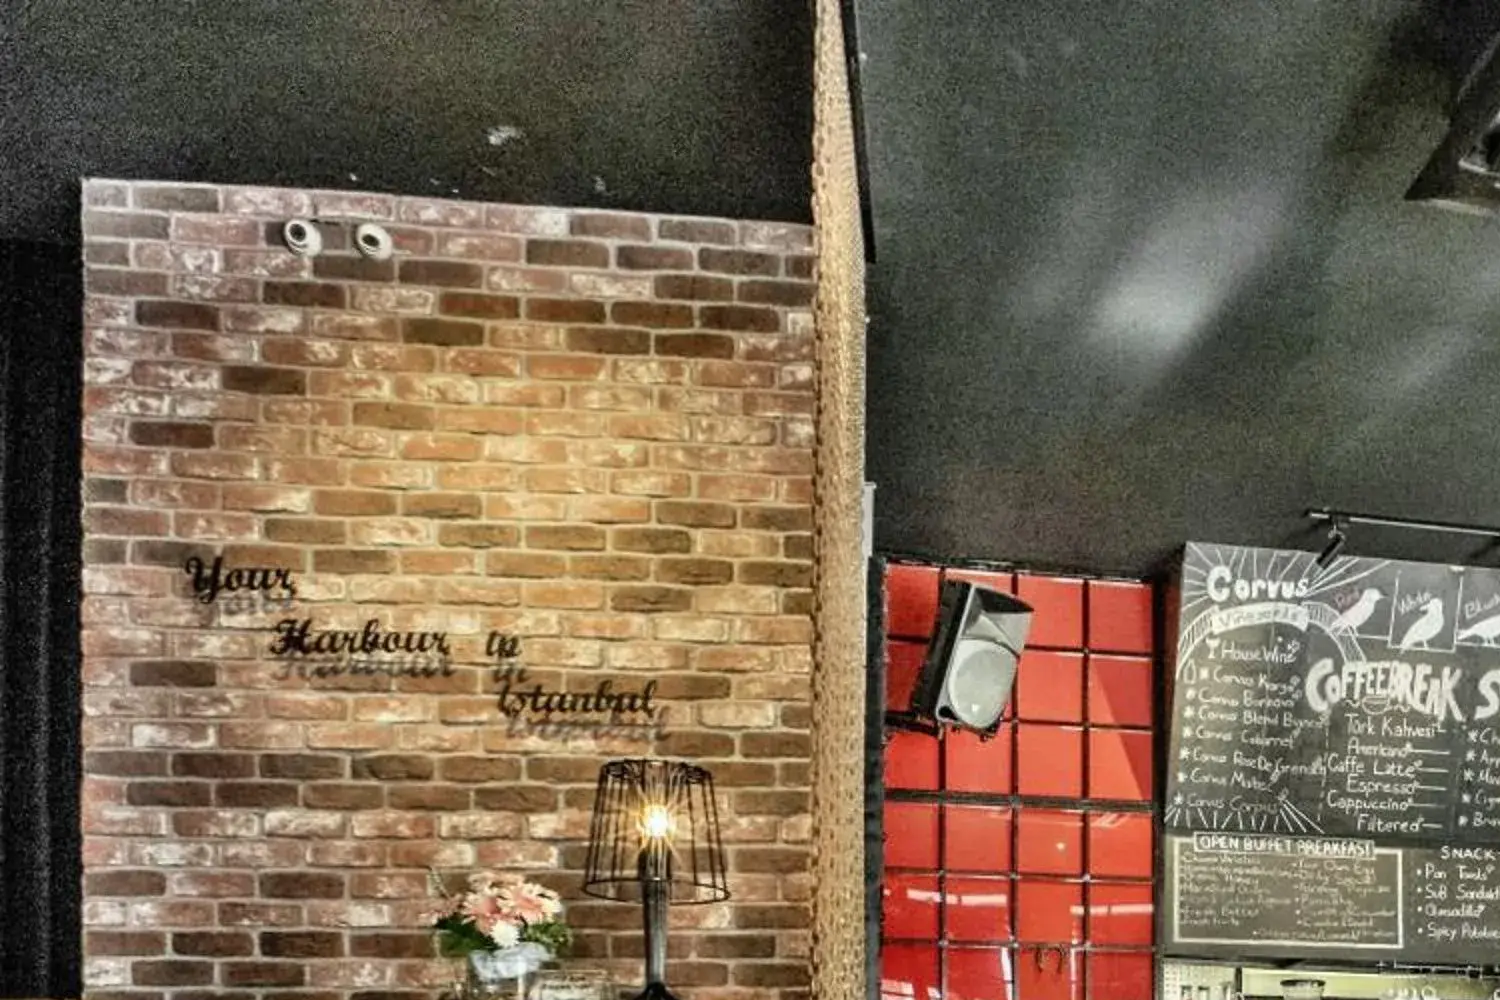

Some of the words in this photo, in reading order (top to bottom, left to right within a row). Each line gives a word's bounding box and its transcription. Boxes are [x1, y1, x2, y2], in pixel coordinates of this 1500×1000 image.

[186, 557, 297, 604] Your
[1207, 565, 1310, 602] Corvus
[270, 618, 450, 657] Harbour
[1221, 639, 1261, 661] House
[498, 679, 658, 718] Istanbul
[1346, 773, 1415, 798] Espresso
[1199, 834, 1239, 850] OPEN
[1441, 845, 1497, 861] SNACK
